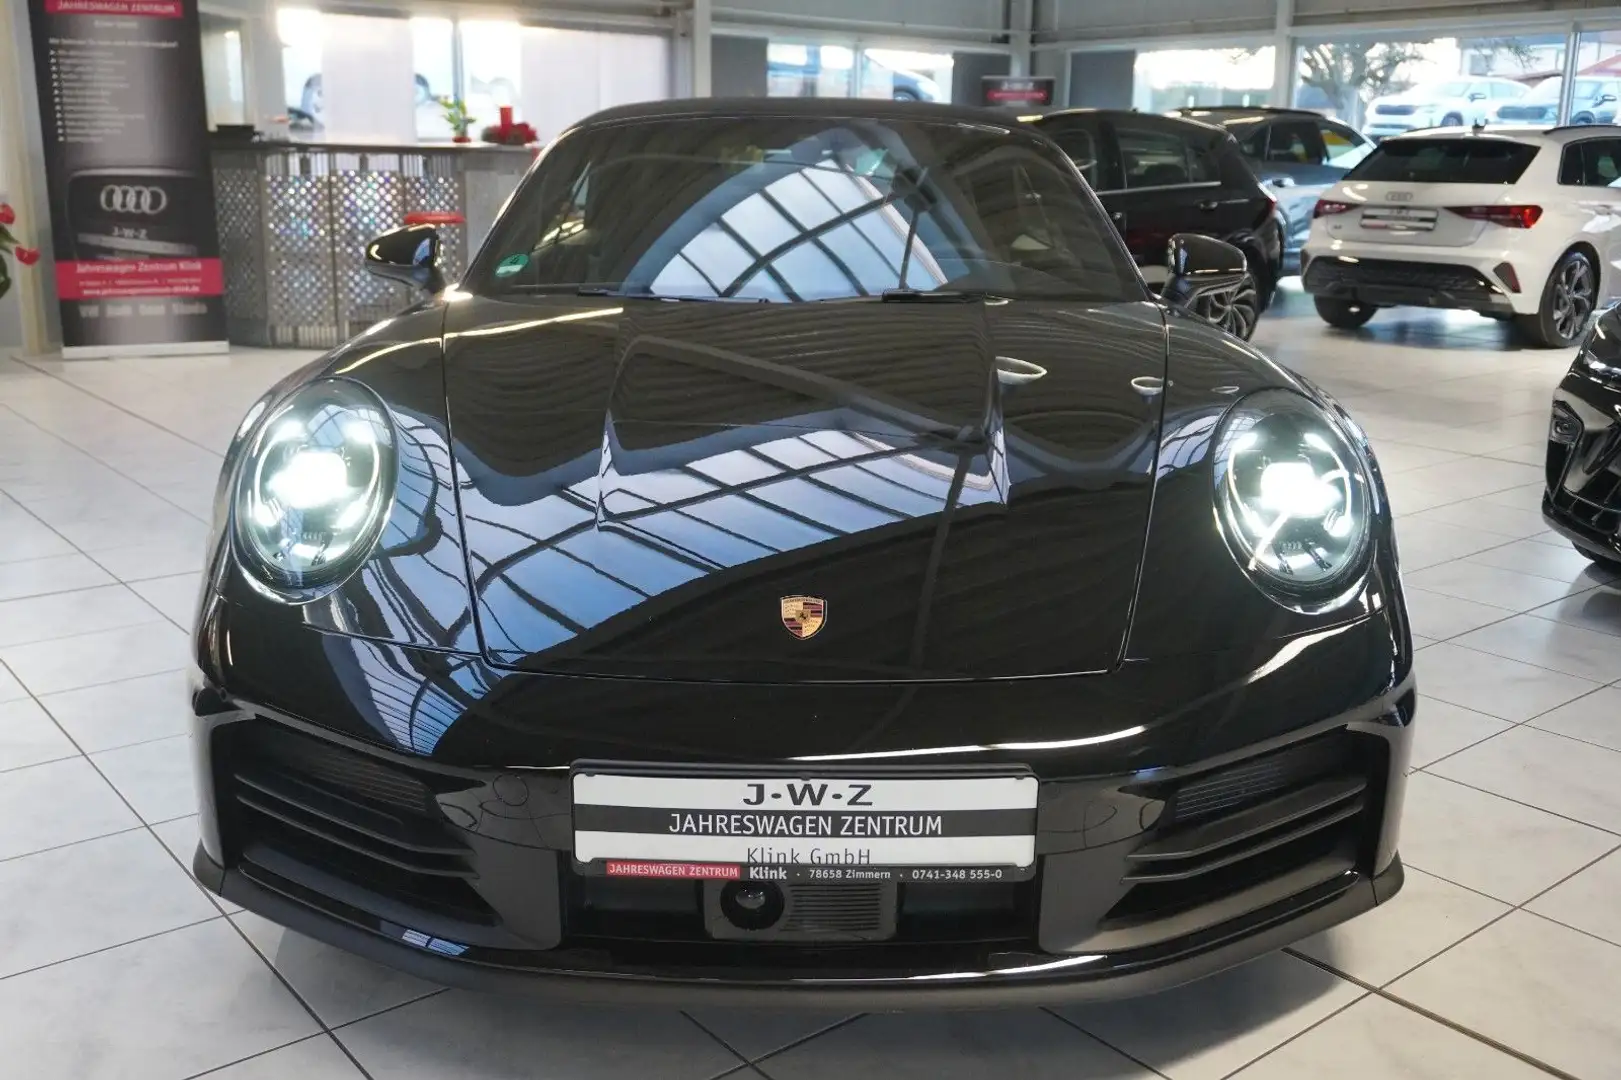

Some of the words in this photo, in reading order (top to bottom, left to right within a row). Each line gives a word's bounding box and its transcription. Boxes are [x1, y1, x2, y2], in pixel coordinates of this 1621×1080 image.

[668, 813, 832, 836] JAHRESWAGEN
[840, 815, 943, 836] ZENTRUM
[746, 847, 801, 864] Klink
[810, 848, 871, 865] GmbH
[609, 863, 685, 876] JAHRESWAGEN
[689, 865, 738, 877] ZENTRUM
[749, 866, 787, 880] Klink
[809, 869, 842, 879] 78658
[845, 869, 891, 879] Zimmern
[912, 869, 966, 880] 0741-348
[970, 869, 1003, 879] 555-0
